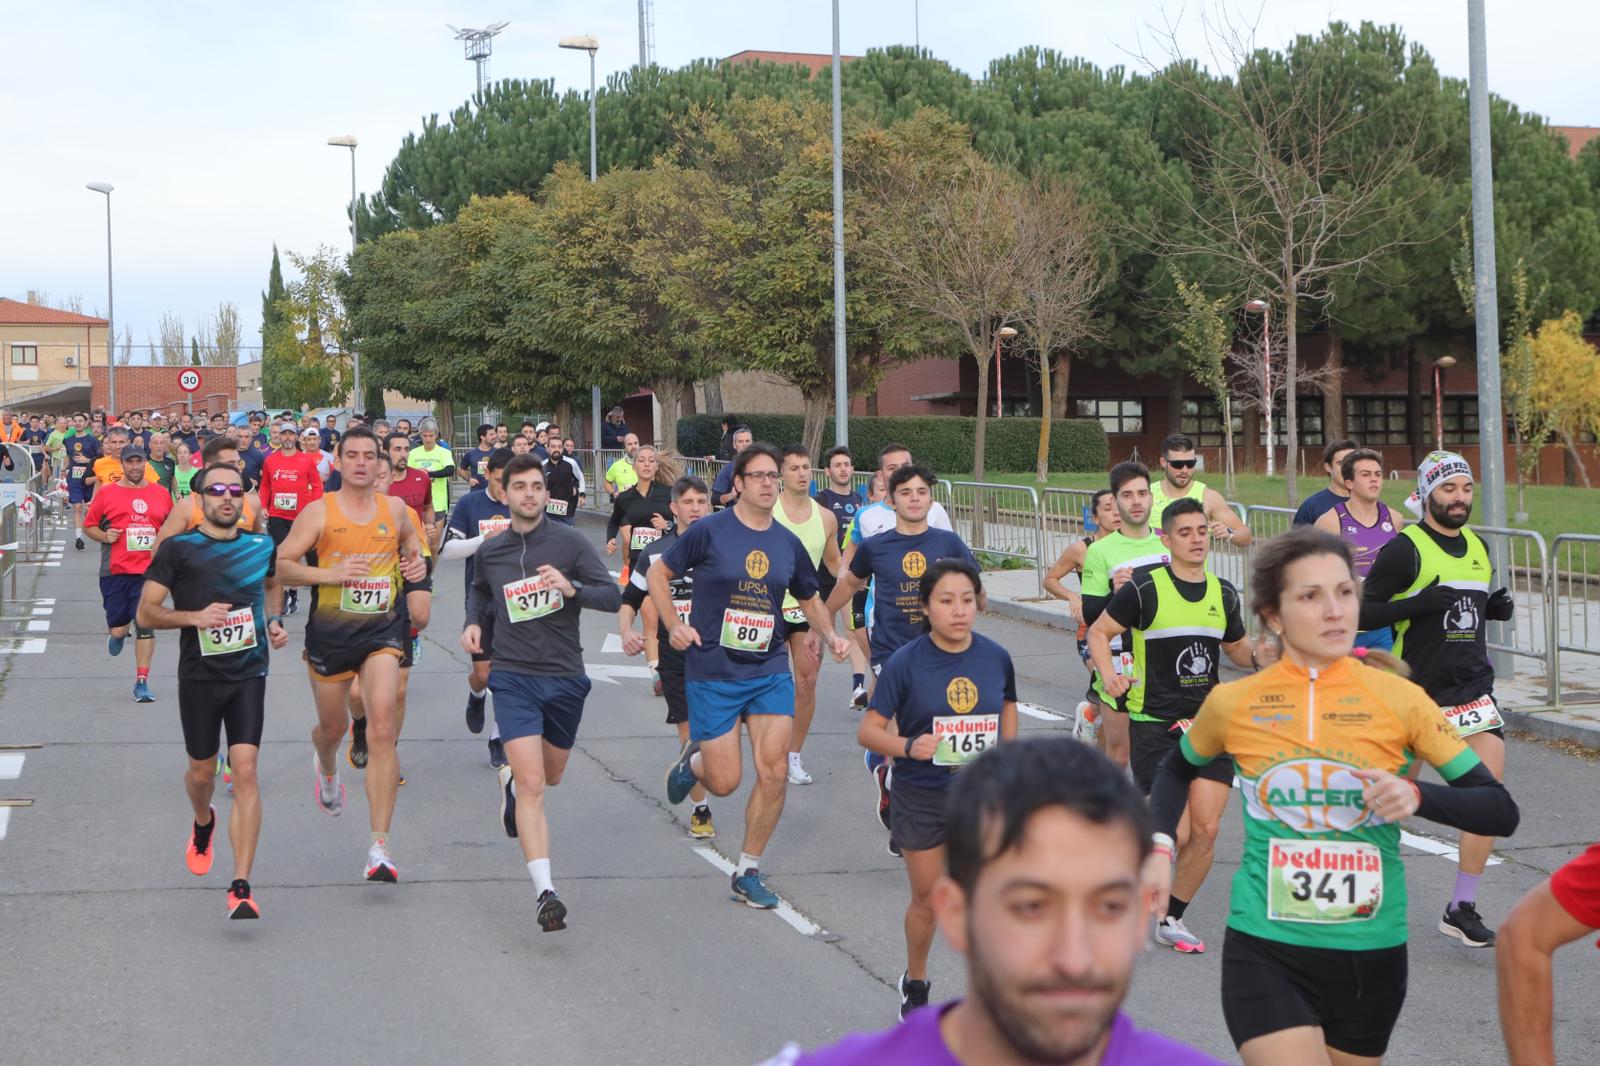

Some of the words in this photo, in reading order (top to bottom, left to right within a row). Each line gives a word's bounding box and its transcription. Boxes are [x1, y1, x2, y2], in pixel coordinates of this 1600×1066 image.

[183, 376, 197, 385] 30
[1440, 461, 1468, 474] SILVES
[1442, 468, 1469, 478] SALMAN
[551, 504, 563, 512] 112
[136, 536, 150, 545] 73
[505, 579, 546, 599] bedun
[738, 580, 768, 595] UPSA
[352, 590, 382, 605] 371
[517, 590, 550, 611] 377
[725, 610, 774, 629] bedunia
[210, 625, 244, 644] 397
[737, 626, 759, 643] 80
[1444, 698, 1492, 718] edunia
[934, 718, 997, 734] bedunia
[1458, 710, 1482, 727] 43
[948, 733, 986, 753] 165
[1266, 787, 1366, 810] ALCER
[1272, 844, 1380, 873] bedunia
[1291, 870, 1357, 904] 341
